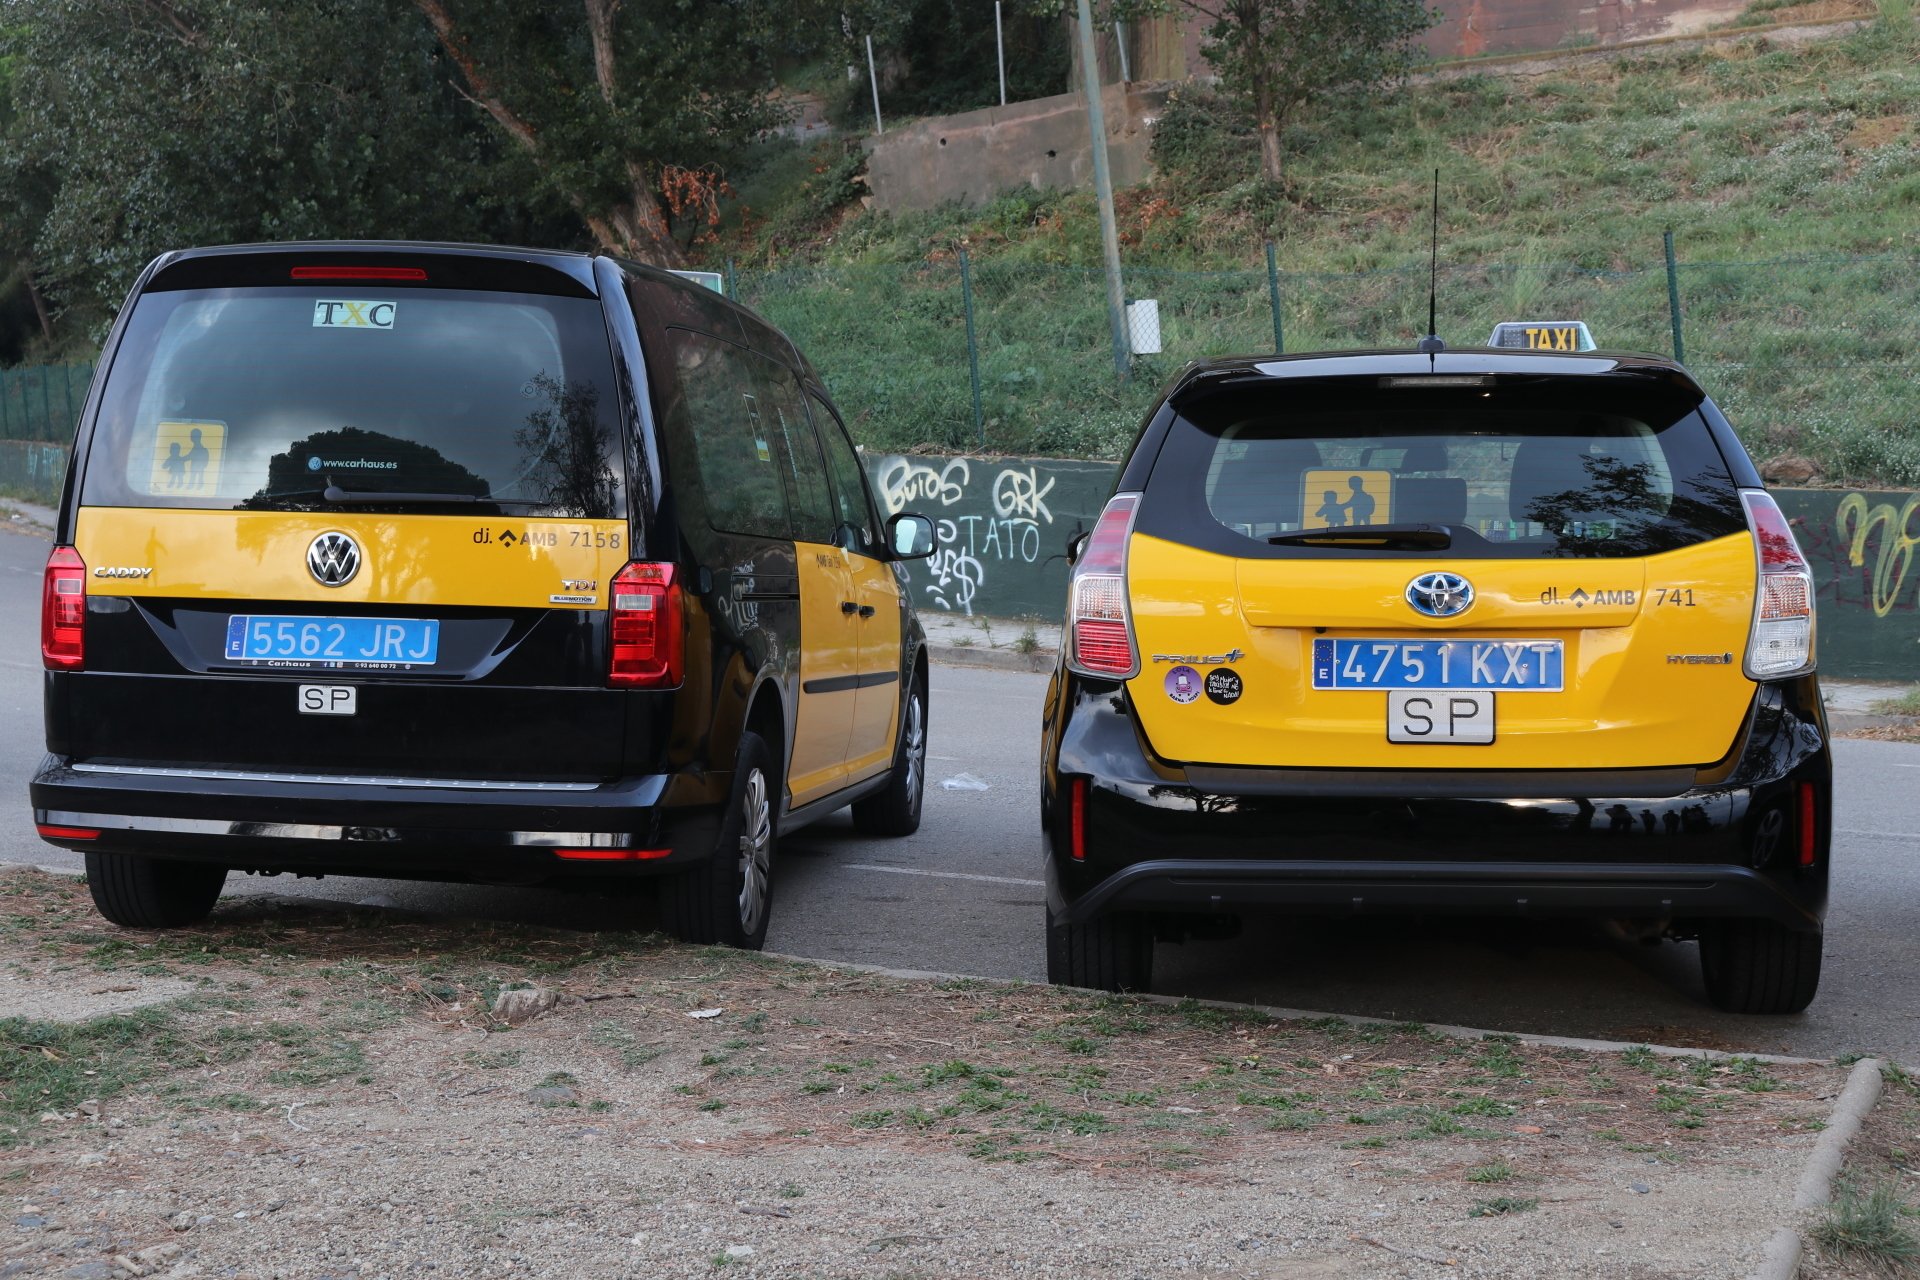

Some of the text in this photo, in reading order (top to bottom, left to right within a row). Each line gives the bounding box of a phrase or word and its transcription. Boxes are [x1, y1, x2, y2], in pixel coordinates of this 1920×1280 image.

[317, 302, 394, 326] TXC
[1525, 328, 1576, 352] TAXI
[322, 457, 398, 469] www.carhaus.es
[519, 532, 558, 547] AMB
[569, 531, 621, 549] 7158
[959, 515, 1040, 563] TATO
[94, 566, 154, 579] CADDY
[1593, 589, 1636, 606] AMB
[1655, 588, 1697, 607] 741
[231, 641, 240, 651] E
[253, 621, 431, 658] 5562 JRJ
[267, 660, 311, 668] Carhaus
[1342, 644, 1555, 685] 4751 KXT
[1666, 654, 1723, 665] HYBRID
[1319, 668, 1329, 679] E
[304, 688, 351, 711] SP
[1403, 697, 1480, 737] SP
